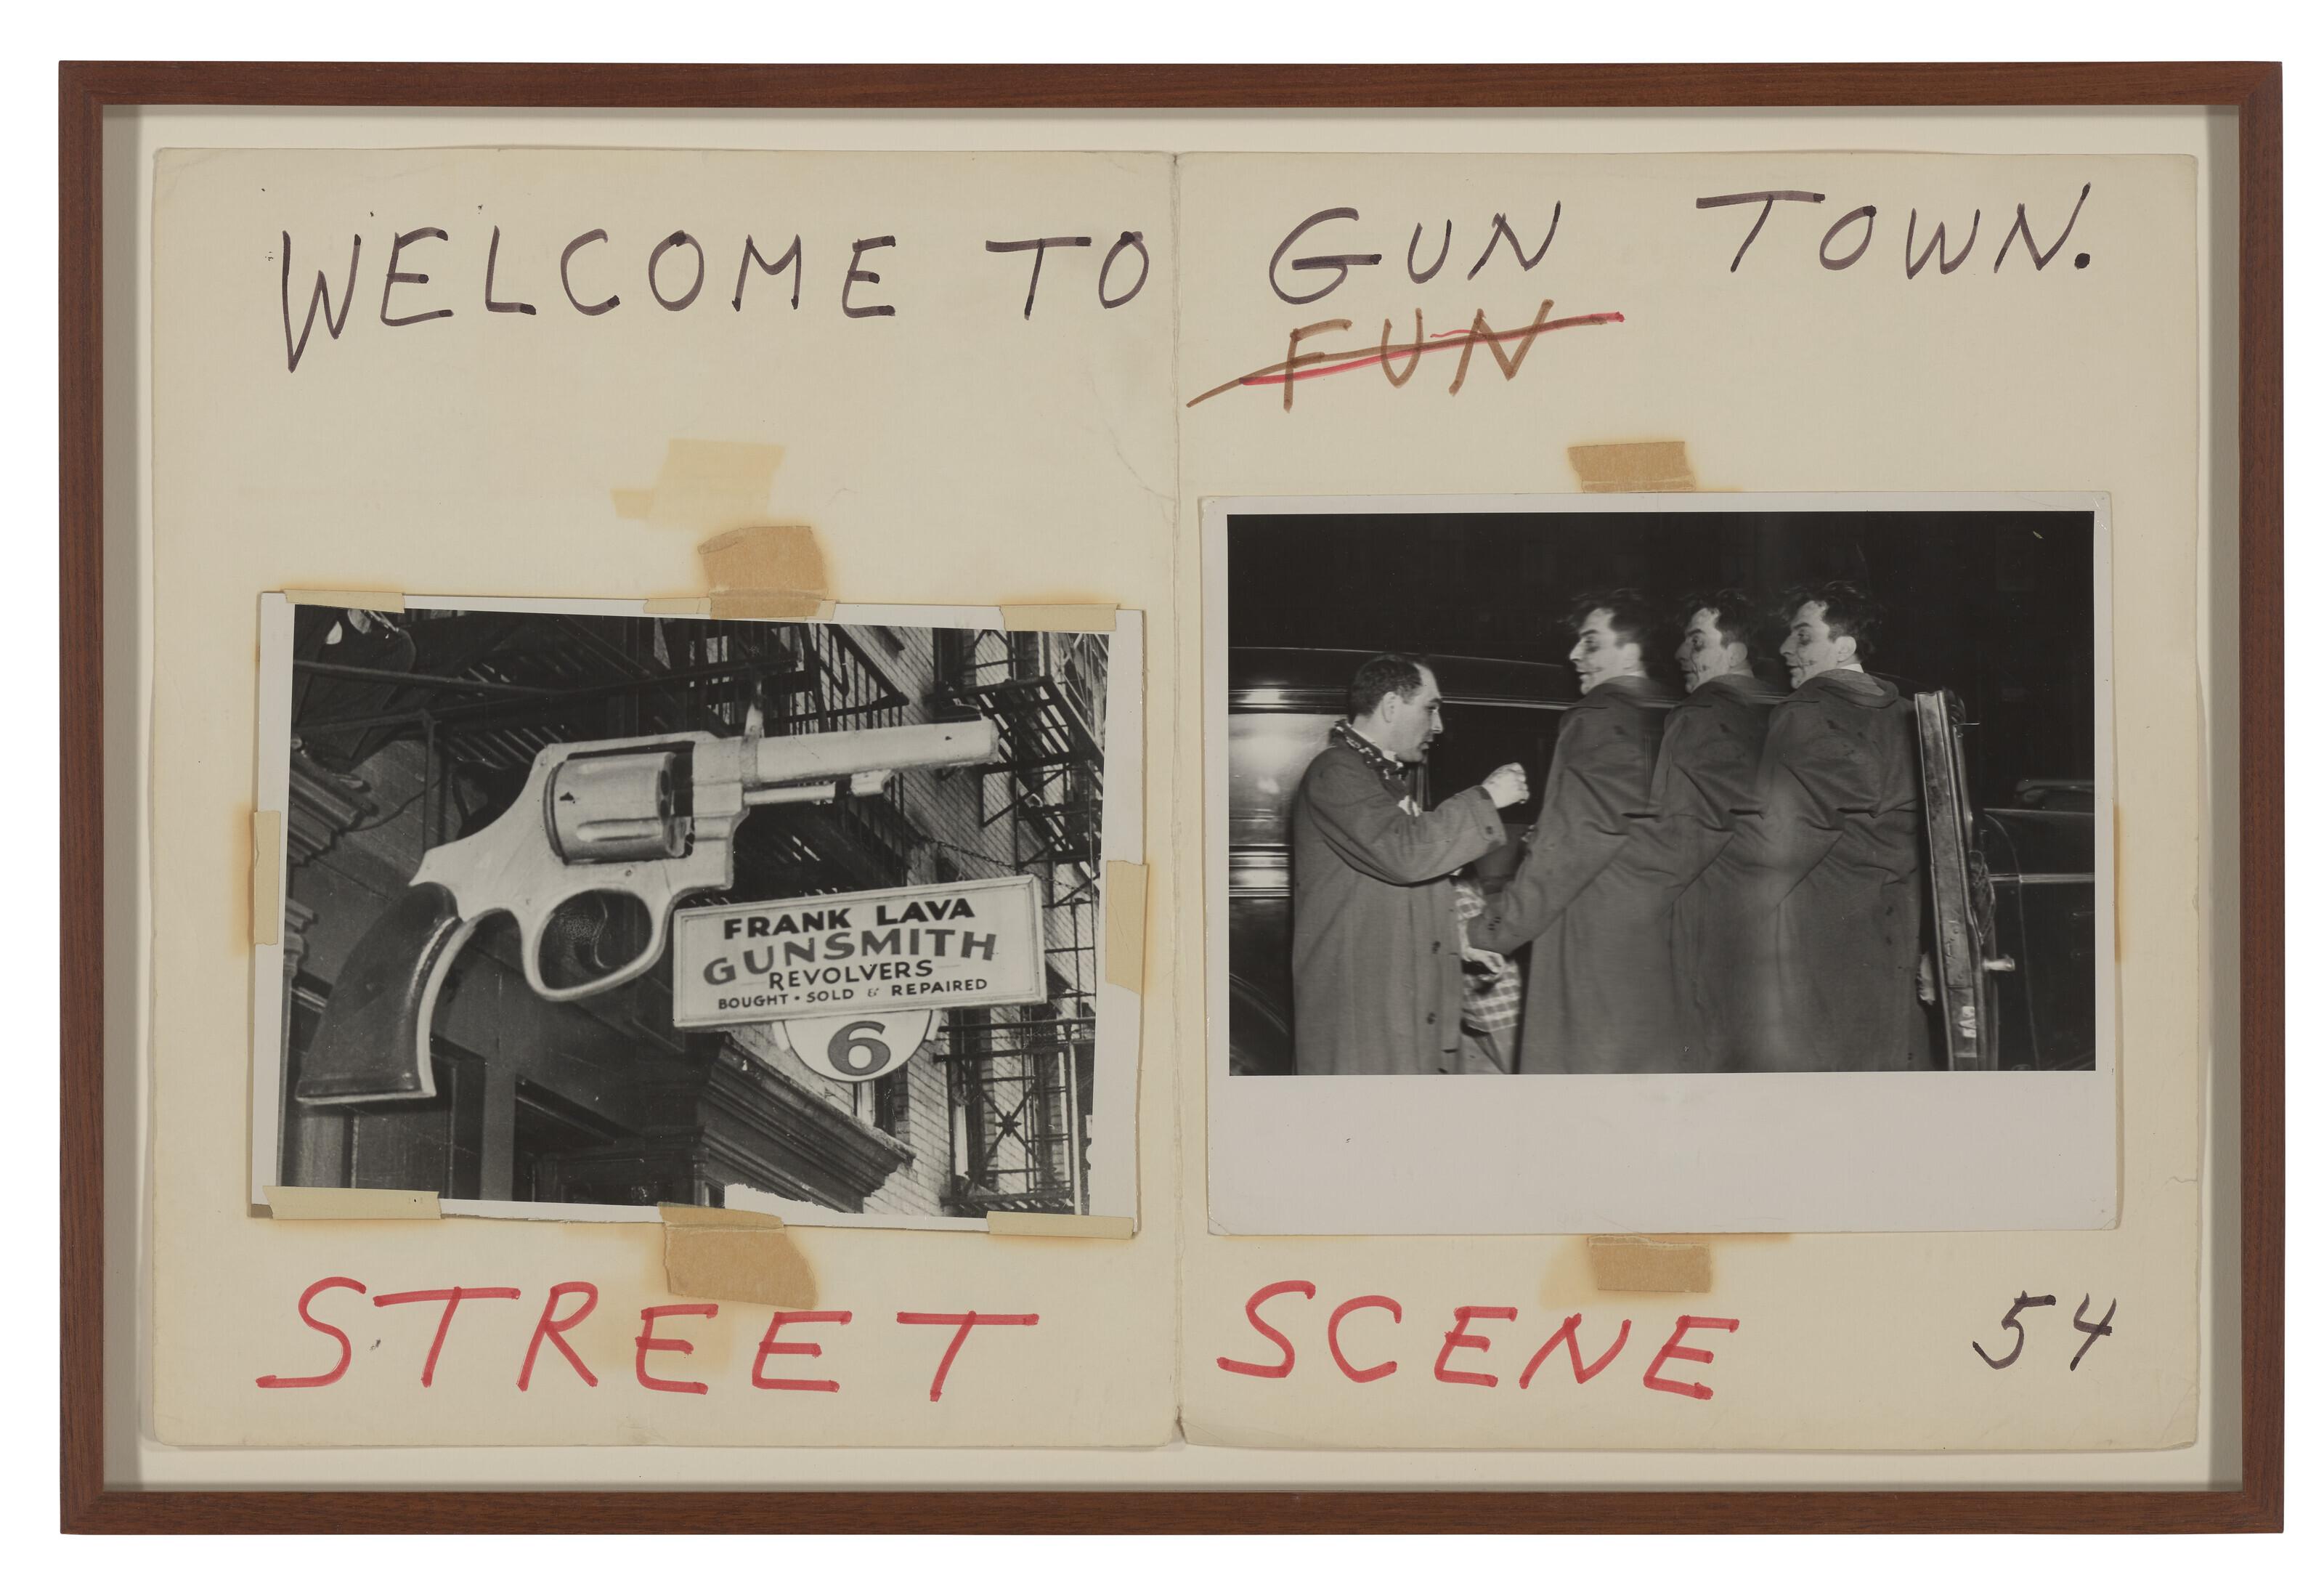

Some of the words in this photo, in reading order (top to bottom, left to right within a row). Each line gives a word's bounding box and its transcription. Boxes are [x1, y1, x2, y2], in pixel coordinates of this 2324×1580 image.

[282, 224, 897, 373] WELCOME
[985, 230, 1150, 319] TO
[1268, 200, 1562, 304] GUN
[1695, 182, 2093, 281] TOWN.
[1282, 299, 1556, 413] FUN
[724, 907, 851, 940] FRANK
[877, 898, 975, 927] LAVA
[703, 928, 997, 986] GUNSMITH
[768, 959, 933, 992] REVOLVERS
[718, 994, 788, 1010] BOUGHT
[806, 988, 854, 1003] SOLD
[891, 979, 988, 996] REPAIRED
[827, 1021, 891, 1076] 6
[256, 1276, 1039, 1402] STREET
[1216, 1279, 1740, 1401] SCENE
